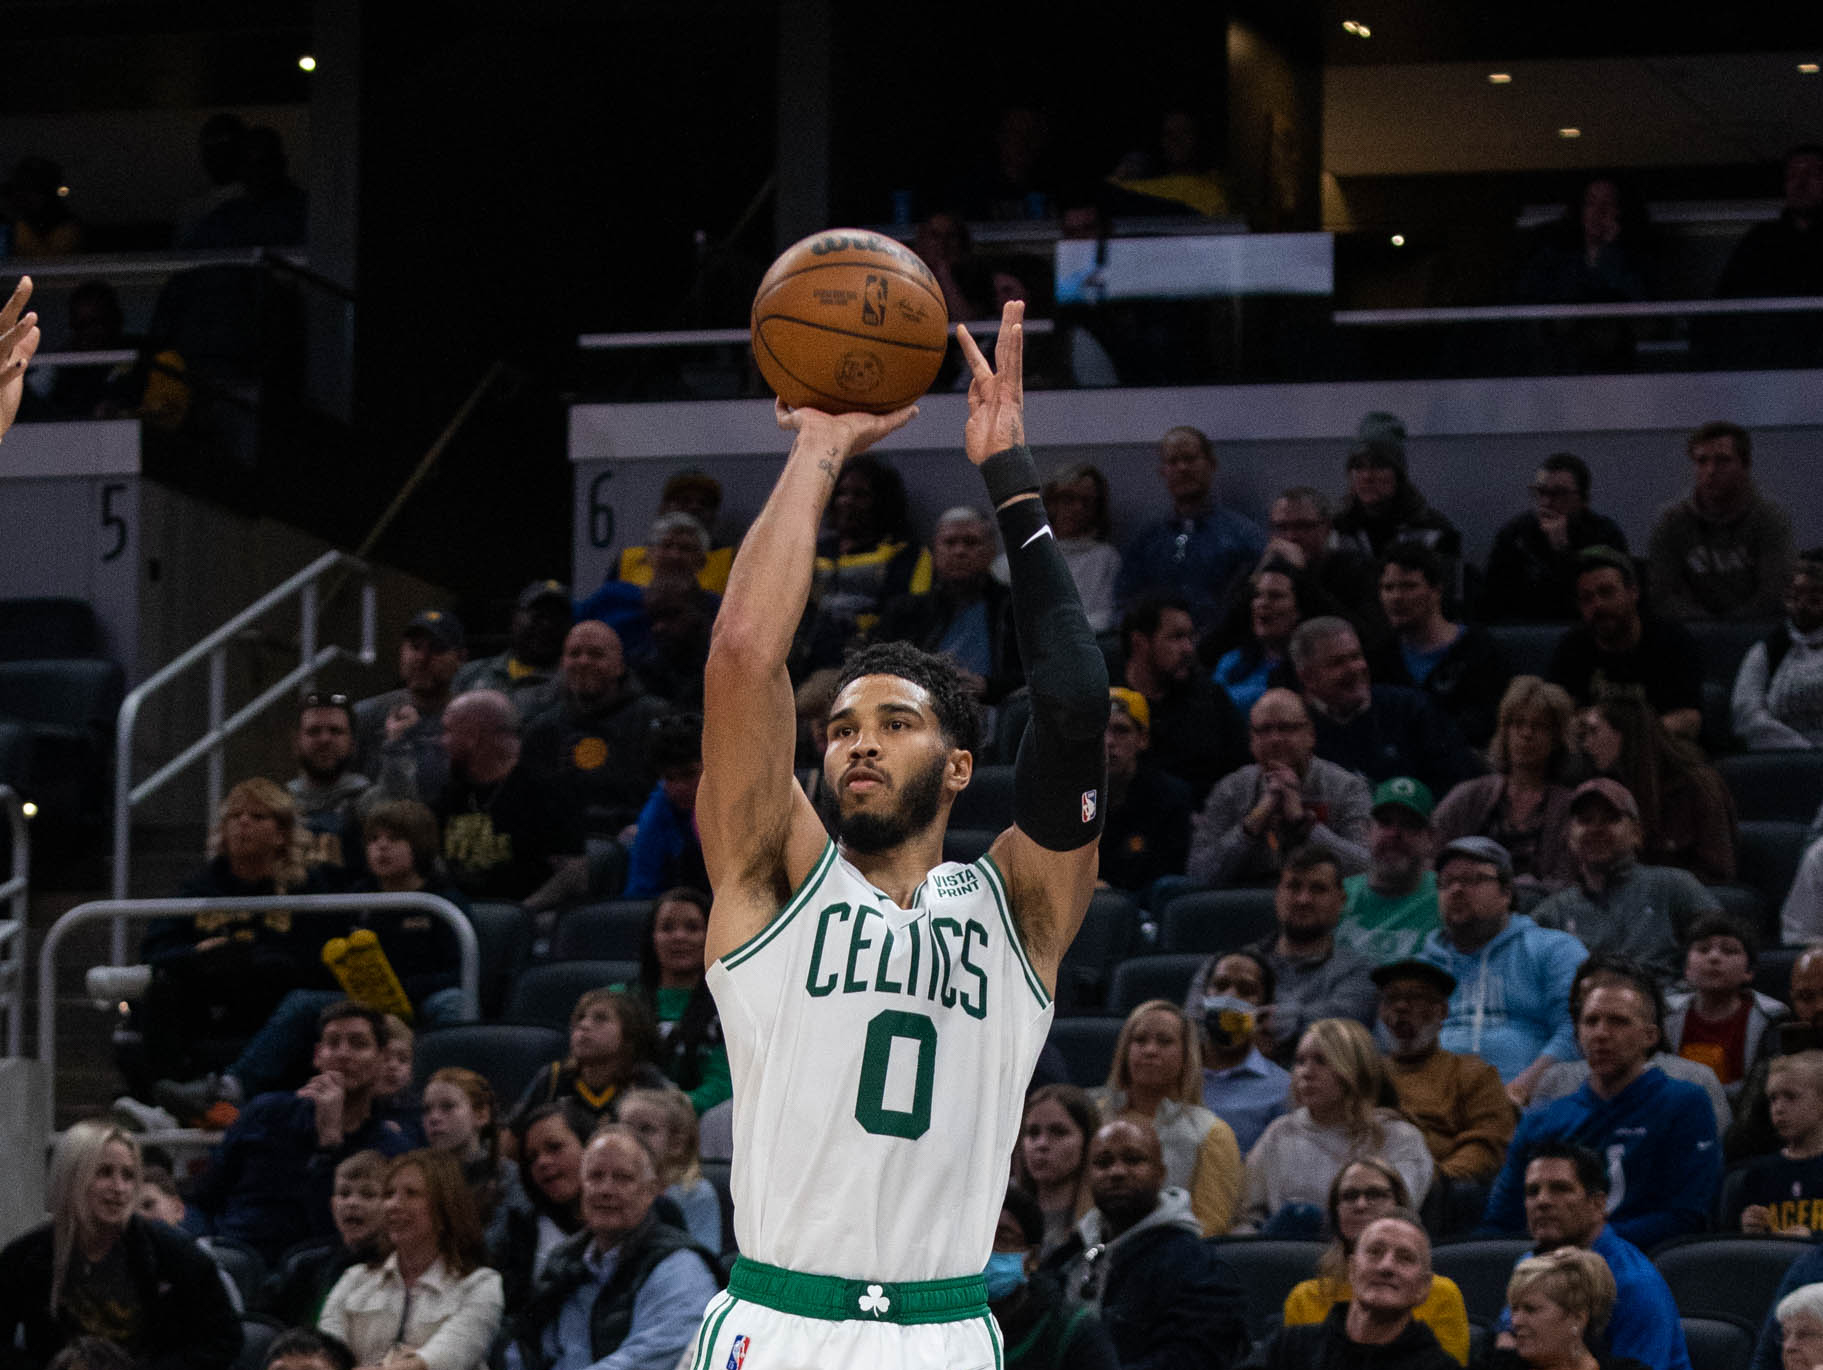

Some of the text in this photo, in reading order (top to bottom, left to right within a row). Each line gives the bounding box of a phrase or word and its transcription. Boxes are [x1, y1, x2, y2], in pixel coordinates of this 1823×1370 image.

[103, 484, 127, 561] 5
[590, 471, 616, 548] 6
[933, 869, 976, 887] VISTA
[937, 880, 979, 897] PRINT
[805, 902, 988, 1020] CELTICS
[855, 1009, 938, 1140] 0
